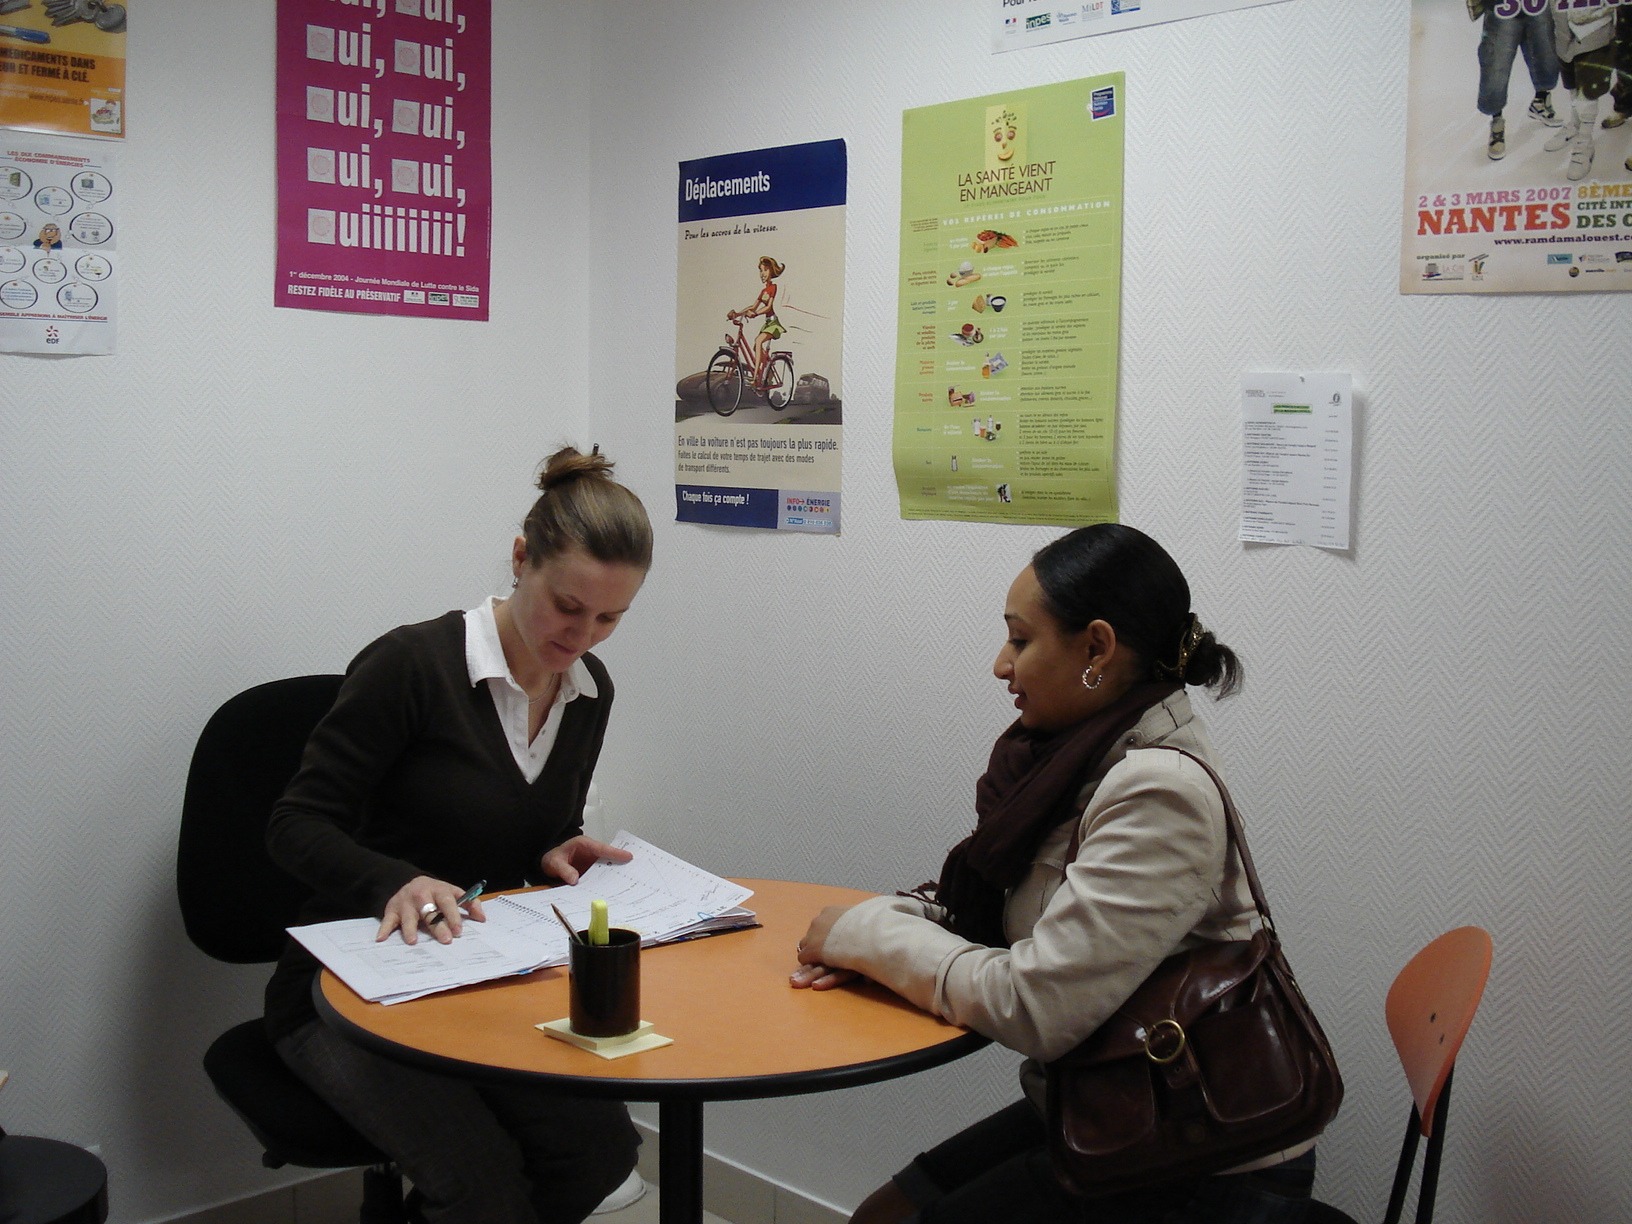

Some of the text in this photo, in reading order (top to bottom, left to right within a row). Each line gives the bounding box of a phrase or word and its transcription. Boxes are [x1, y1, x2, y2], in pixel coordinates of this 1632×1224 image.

[19, 63, 28, 74] ET
[31, 65, 60, 79] FERMÉ
[71, 56, 95, 70] DANS
[958, 161, 1056, 186] LA SANTÉ VIENT
[686, 171, 770, 205] Déplacements
[960, 188, 976, 201] EN
[980, 178, 1052, 199] MANGEANT
[1419, 187, 1572, 207] 2 & 3 MARS 2007
[1577, 199, 1607, 210] CITÉ
[1026, 201, 1110, 216] CONSOMMATION
[1417, 202, 1571, 235] NANTES
[1576, 214, 1616, 228] DES
[685, 230, 699, 240] Pour
[701, 228, 709, 238] les
[734, 224, 741, 235] de
[744, 223, 750, 234] la
[753, 225, 778, 234] vitesse.
[299, 272, 332, 280] décembre
[355, 276, 380, 285] Journée
[382, 278, 410, 287] Mondiale
[421, 281, 436, 289] Lutte
[438, 283, 457, 291] contre
[466, 284, 479, 292] Sida
[287, 284, 316, 296] RESTEZ
[318, 286, 343, 298] FIDÈLE
[344, 289, 354, 299] AU
[356, 288, 401, 302] PRÉSERVATIF
[678, 435, 839, 452] En ville la voiture n'est pas toujours la plus rapide.
[678, 450, 691, 459] Faites
[692, 451, 696, 459] le
[698, 451, 712, 460] calcul
[713, 452, 719, 460] de
[734, 453, 748, 462] temps
[750, 453, 756, 461] de
[757, 453, 770, 463] trajet
[785, 454, 795, 462] des
[796, 454, 815, 463] modes
[678, 463, 730, 473] de transport différents.
[682, 491, 749, 507] Chaque fois ça compte !
